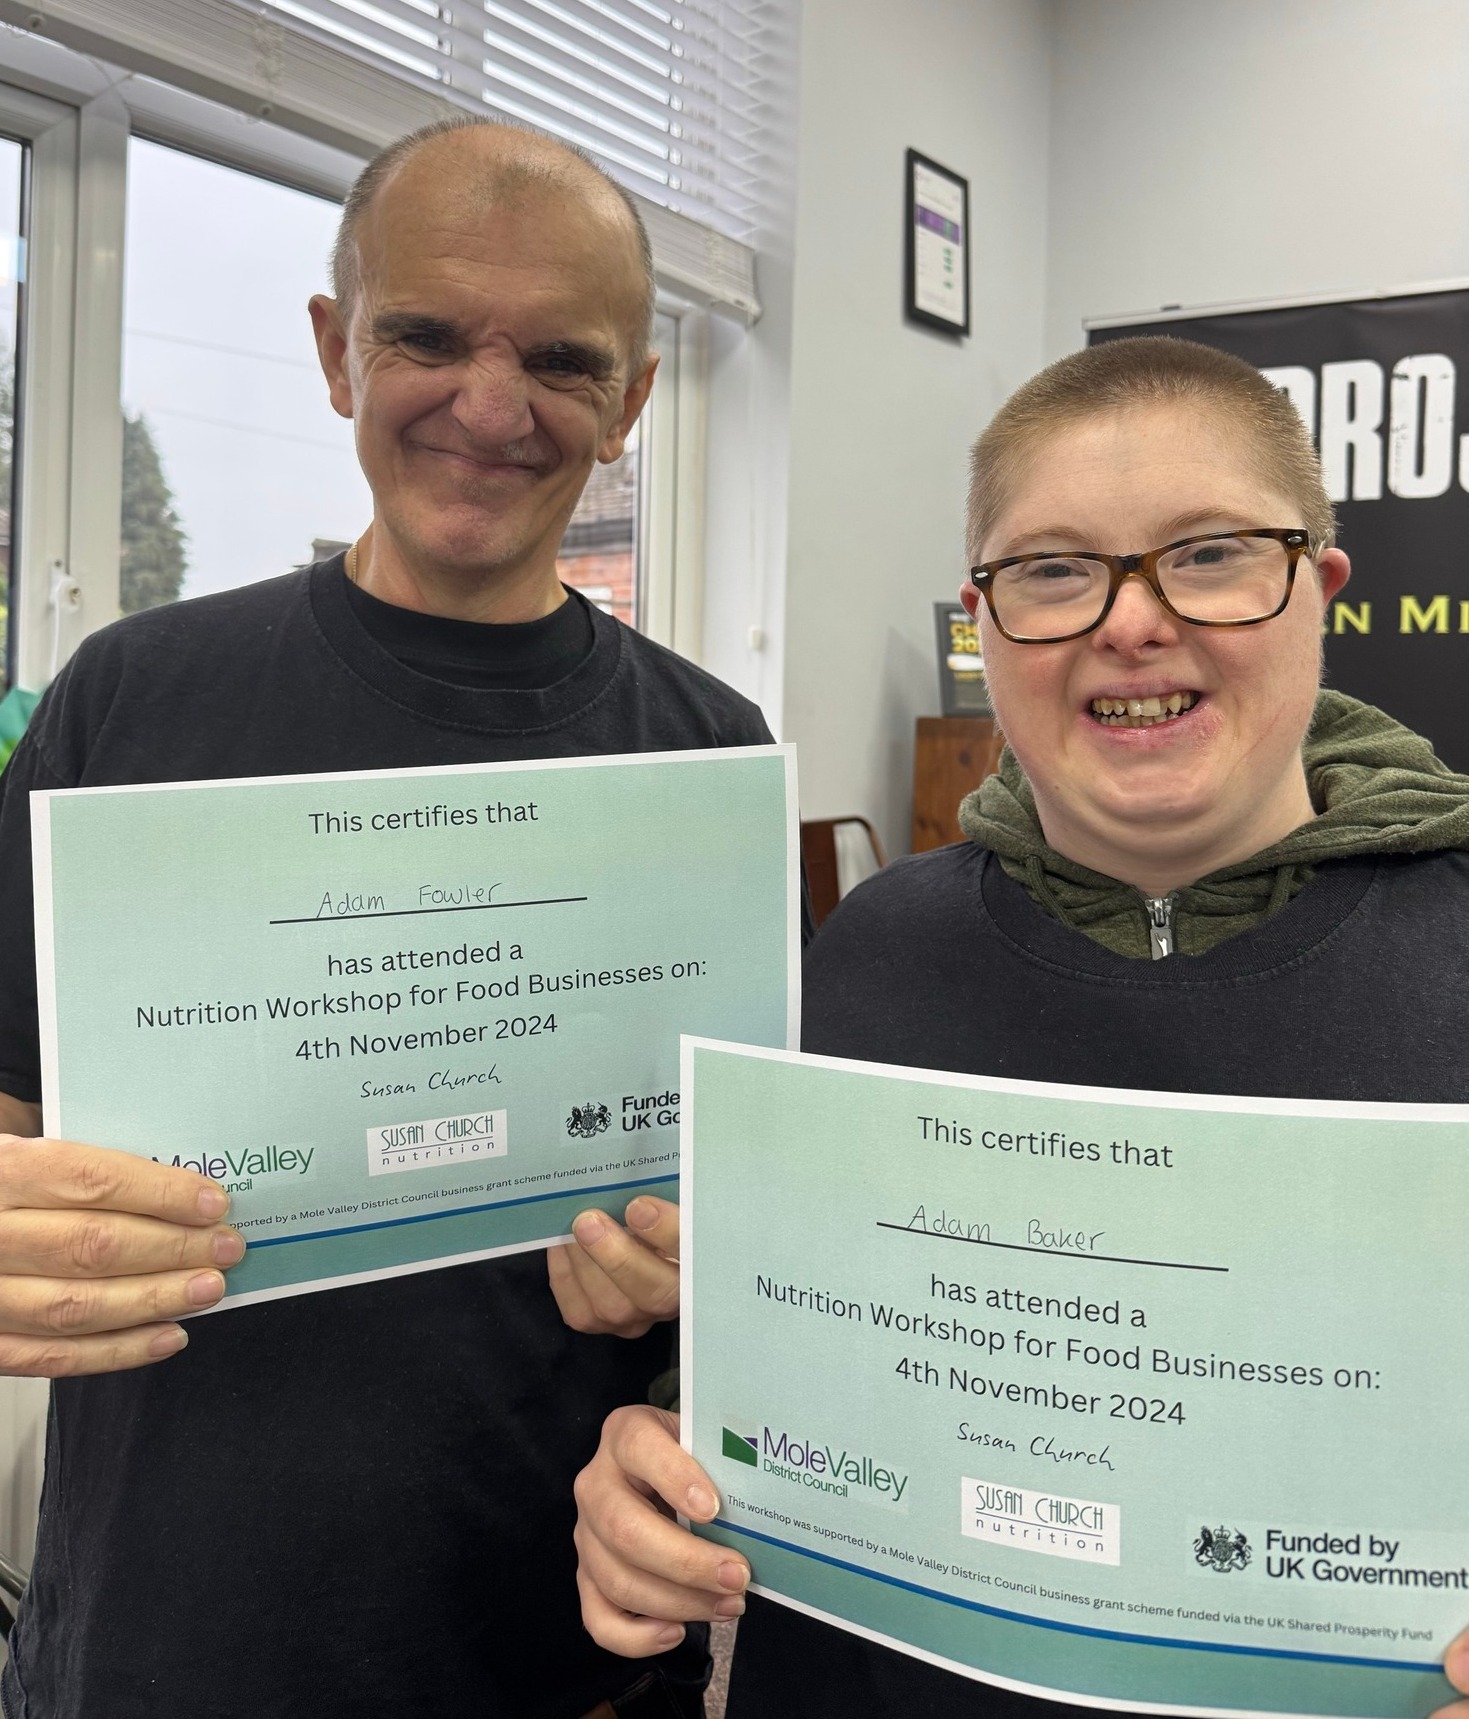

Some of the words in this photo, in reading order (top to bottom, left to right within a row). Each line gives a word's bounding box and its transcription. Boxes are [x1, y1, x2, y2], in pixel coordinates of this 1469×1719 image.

[309, 811, 362, 834] This
[371, 805, 478, 830] certifies
[485, 801, 538, 823] that
[316, 892, 385, 918] Adam
[419, 882, 502, 905] Fowler
[327, 954, 373, 976] has
[381, 941, 500, 972] attended
[509, 943, 523, 960] a
[136, 1001, 257, 1028] Nutrition
[266, 991, 402, 1019] Workshop
[409, 985, 447, 1006] for
[456, 976, 519, 1002] Food
[529, 966, 664, 994] Businesses
[671, 959, 707, 977] on:
[296, 1036, 340, 1060] 4th
[350, 1022, 488, 1055] November
[495, 1014, 558, 1040] 2024
[361, 1081, 415, 1098] Susan
[428, 1064, 502, 1090] Church
[622, 1091, 680, 1112] Funde
[381, 1124, 424, 1151] SUSAN
[435, 1115, 493, 1141] CHURCH
[622, 1112, 652, 1132] UK
[382, 1141, 494, 1165] nutrition
[917, 1116, 973, 1146] This
[981, 1130, 1101, 1161] certifies
[1110, 1140, 1173, 1168] that
[222, 1179, 253, 1193] uncil
[230, 1215, 273, 1230] pported
[275, 1213, 288, 1224] by
[300, 1208, 325, 1220] Mole
[327, 1203, 359, 1216] Valley
[361, 1197, 399, 1210] District
[401, 1190, 439, 1203] Council
[441, 1184, 484, 1197] business
[486, 1179, 512, 1191] grant
[514, 1173, 551, 1185] scheme
[553, 1166, 587, 1179] funded
[605, 1161, 621, 1171] the
[623, 1159, 636, 1168] UK
[638, 1153, 670, 1165] Shared
[907, 1205, 990, 1242] Adam
[1028, 1219, 1106, 1250] Baker
[931, 1273, 977, 1304] has
[985, 1287, 1120, 1325] attended
[1131, 1308, 1147, 1328] a
[757, 1275, 862, 1321] Nutrition
[870, 1302, 1005, 1355] Workshop
[1014, 1330, 1056, 1358] for
[1066, 1338, 1140, 1370] Food
[1152, 1348, 1324, 1386] Businesses
[1334, 1367, 1381, 1389] on:
[896, 1357, 939, 1386] 4th
[950, 1367, 1100, 1414] November
[1110, 1394, 1186, 1425] 2024
[764, 1426, 908, 1502] MoleValley
[957, 1422, 1016, 1452] Susan
[1030, 1436, 1115, 1471] Church
[764, 1459, 801, 1483] District
[803, 1473, 848, 1498] Council
[976, 1485, 1023, 1516] SUSAN
[1035, 1497, 1103, 1530] CHURCH
[976, 1517, 1104, 1551] nutrition
[1266, 1529, 1361, 1555] Funded
[1369, 1535, 1400, 1562] by
[727, 1494, 746, 1509] This
[747, 1504, 792, 1525] workshop
[793, 1519, 811, 1531] was
[813, 1524, 864, 1547] supported
[866, 1539, 879, 1553] by
[881, 1546, 887, 1554] a
[889, 1547, 915, 1563] Mole
[917, 1555, 949, 1574] Valley
[951, 1565, 992, 1585] District
[994, 1577, 1037, 1595] Council
[1039, 1586, 1090, 1605] business
[1093, 1597, 1124, 1611] grant
[1128, 1603, 1174, 1617] scheme
[1177, 1608, 1220, 1622] funded
[1223, 1613, 1241, 1624] via
[1244, 1615, 1265, 1627] the
[1267, 1617, 1285, 1629] UK
[1287, 1618, 1331, 1633] Shared
[1334, 1623, 1399, 1640] Prosperity
[1401, 1628, 1433, 1641] Fund
[1266, 1556, 1305, 1580] UK
[1312, 1558, 1469, 1589] Government
